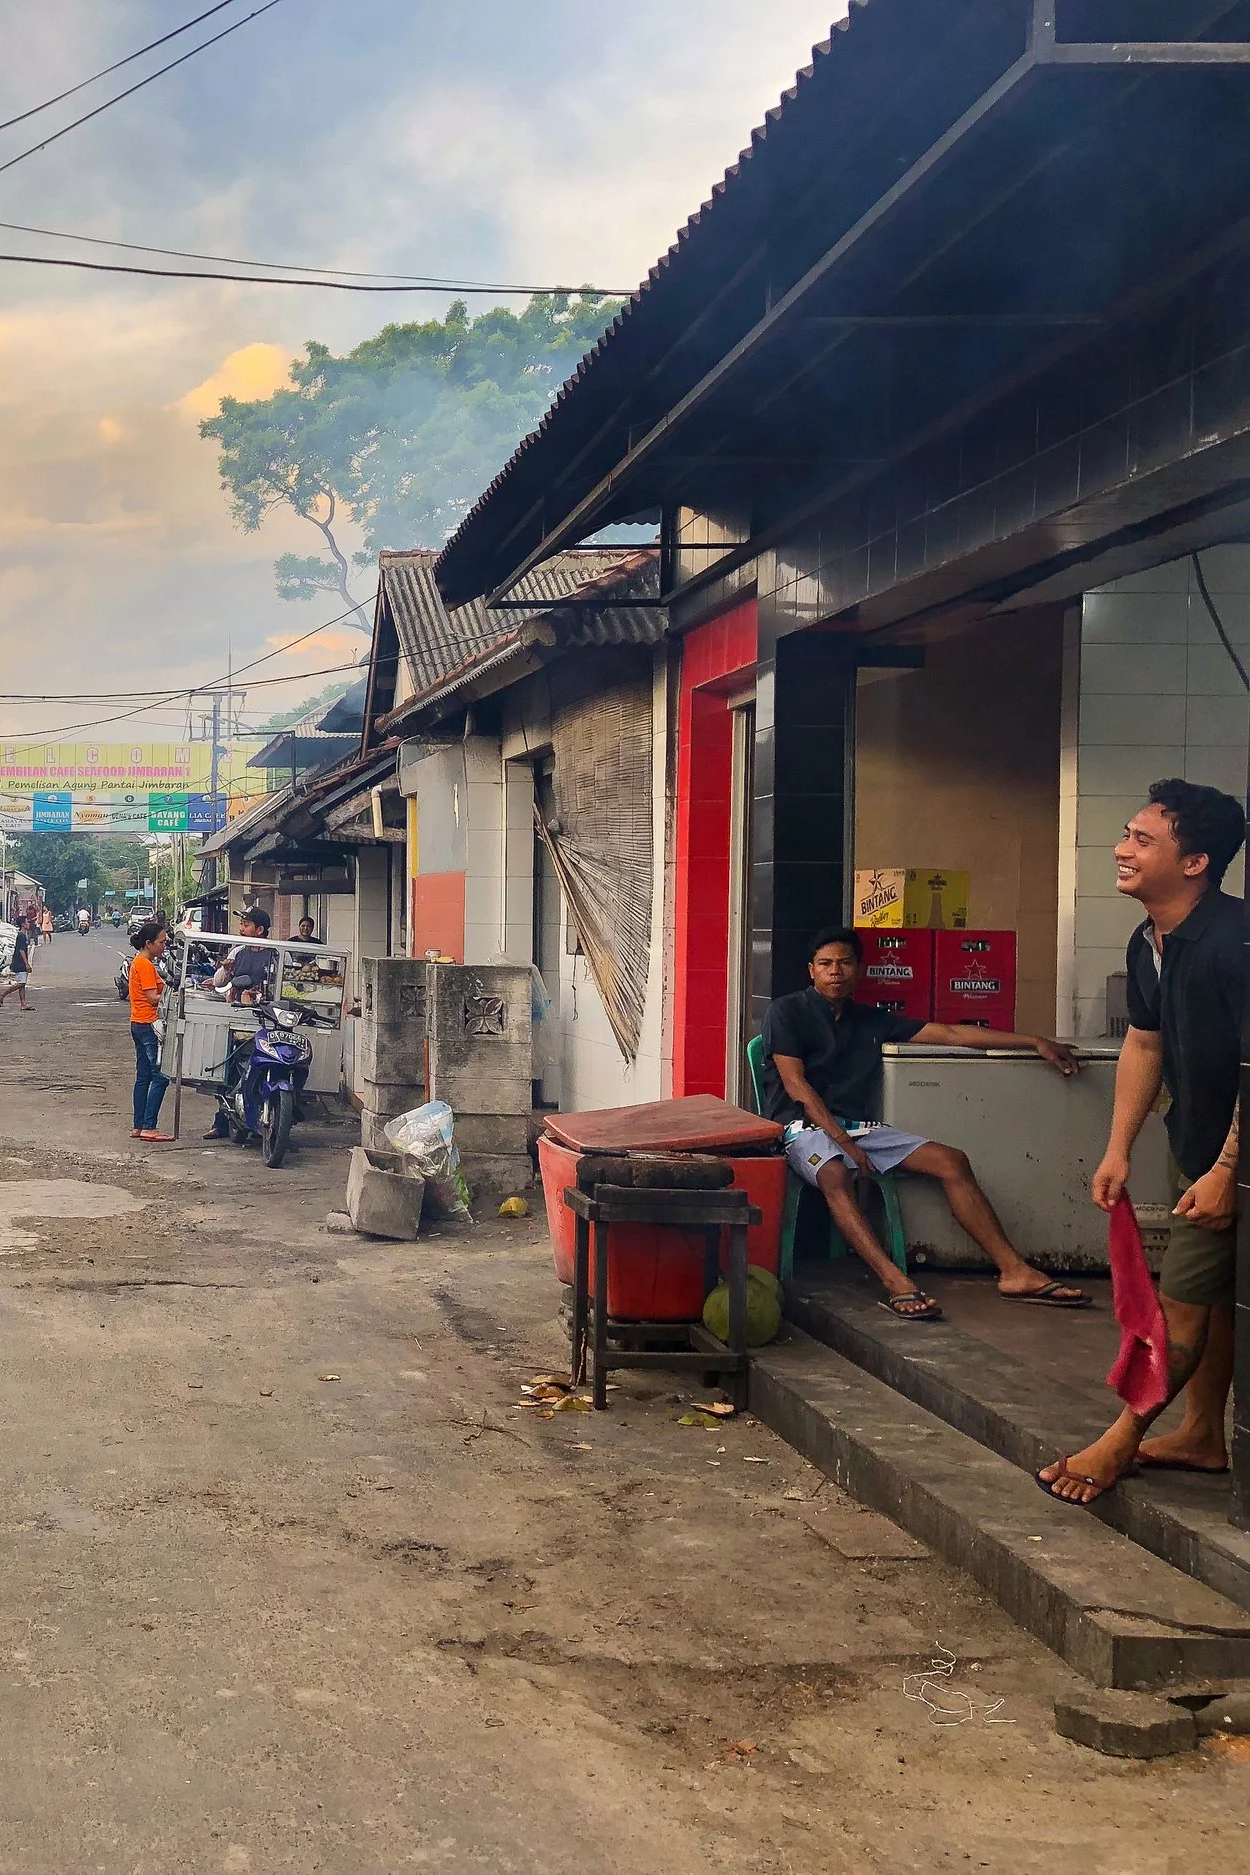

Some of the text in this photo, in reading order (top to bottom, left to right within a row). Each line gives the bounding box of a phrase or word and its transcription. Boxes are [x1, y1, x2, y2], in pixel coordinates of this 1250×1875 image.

[49, 766, 76, 777] CAFE
[77, 766, 126, 777] SEAFOOD
[127, 766, 183, 777] JIMBARAN
[8, 780, 59, 789] Pemelisan
[62, 780, 97, 791] Agung
[101, 780, 135, 789] Pantai
[138, 780, 190, 789] Jimbaran
[860, 886, 897, 915] BINTANG
[869, 967, 911, 976] BINTANG
[954, 981, 996, 990] BINTANG
